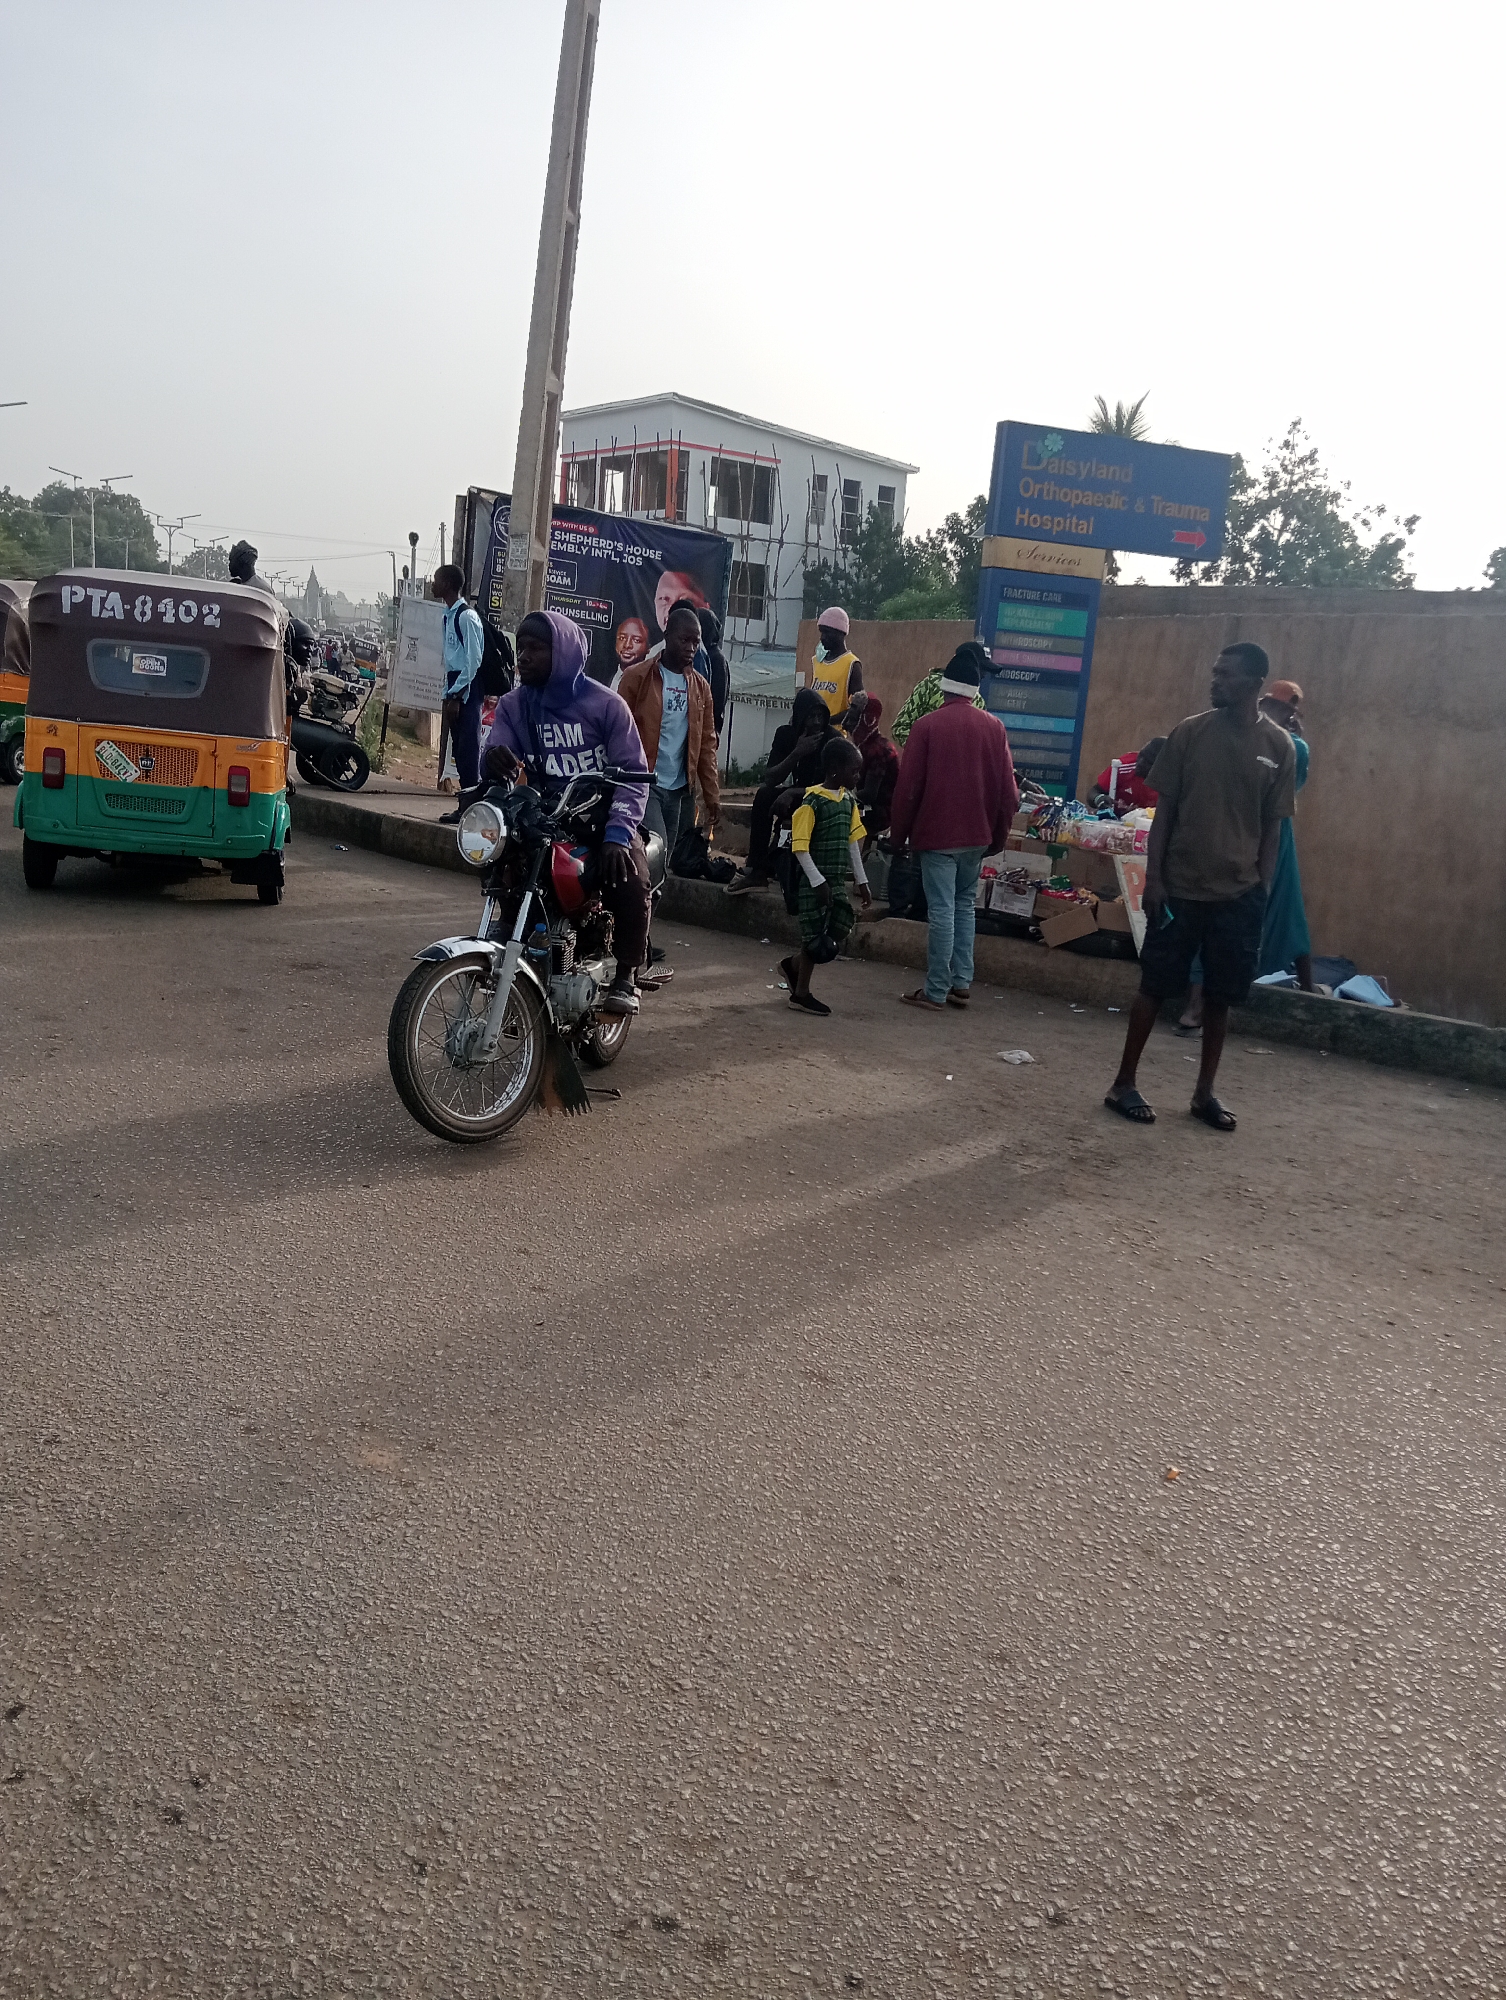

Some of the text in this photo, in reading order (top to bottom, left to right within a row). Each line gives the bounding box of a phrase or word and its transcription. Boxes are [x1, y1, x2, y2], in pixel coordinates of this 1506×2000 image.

[1021, 441, 1133, 483] Daisyland
[1019, 477, 1210, 521] Orthopaedic & Trauma
[1015, 507, 1094, 535] Hospital
[550, 541, 589, 555] EMBLY
[622, 553, 643, 567] JOS
[554, 531, 624, 552] SHEPHERD'S
[626, 544, 663, 561] HOUSE
[1017, 545, 1083, 567] Services
[550, 595, 582, 605] THURSDAY
[1003, 587, 1063, 603] FRACTURE CARE
[549, 605, 609, 623] COUNSELLING
[728, 694, 752, 705] EDAR
[754, 698, 778, 708] TREE
[525, 744, 609, 778] ADER
